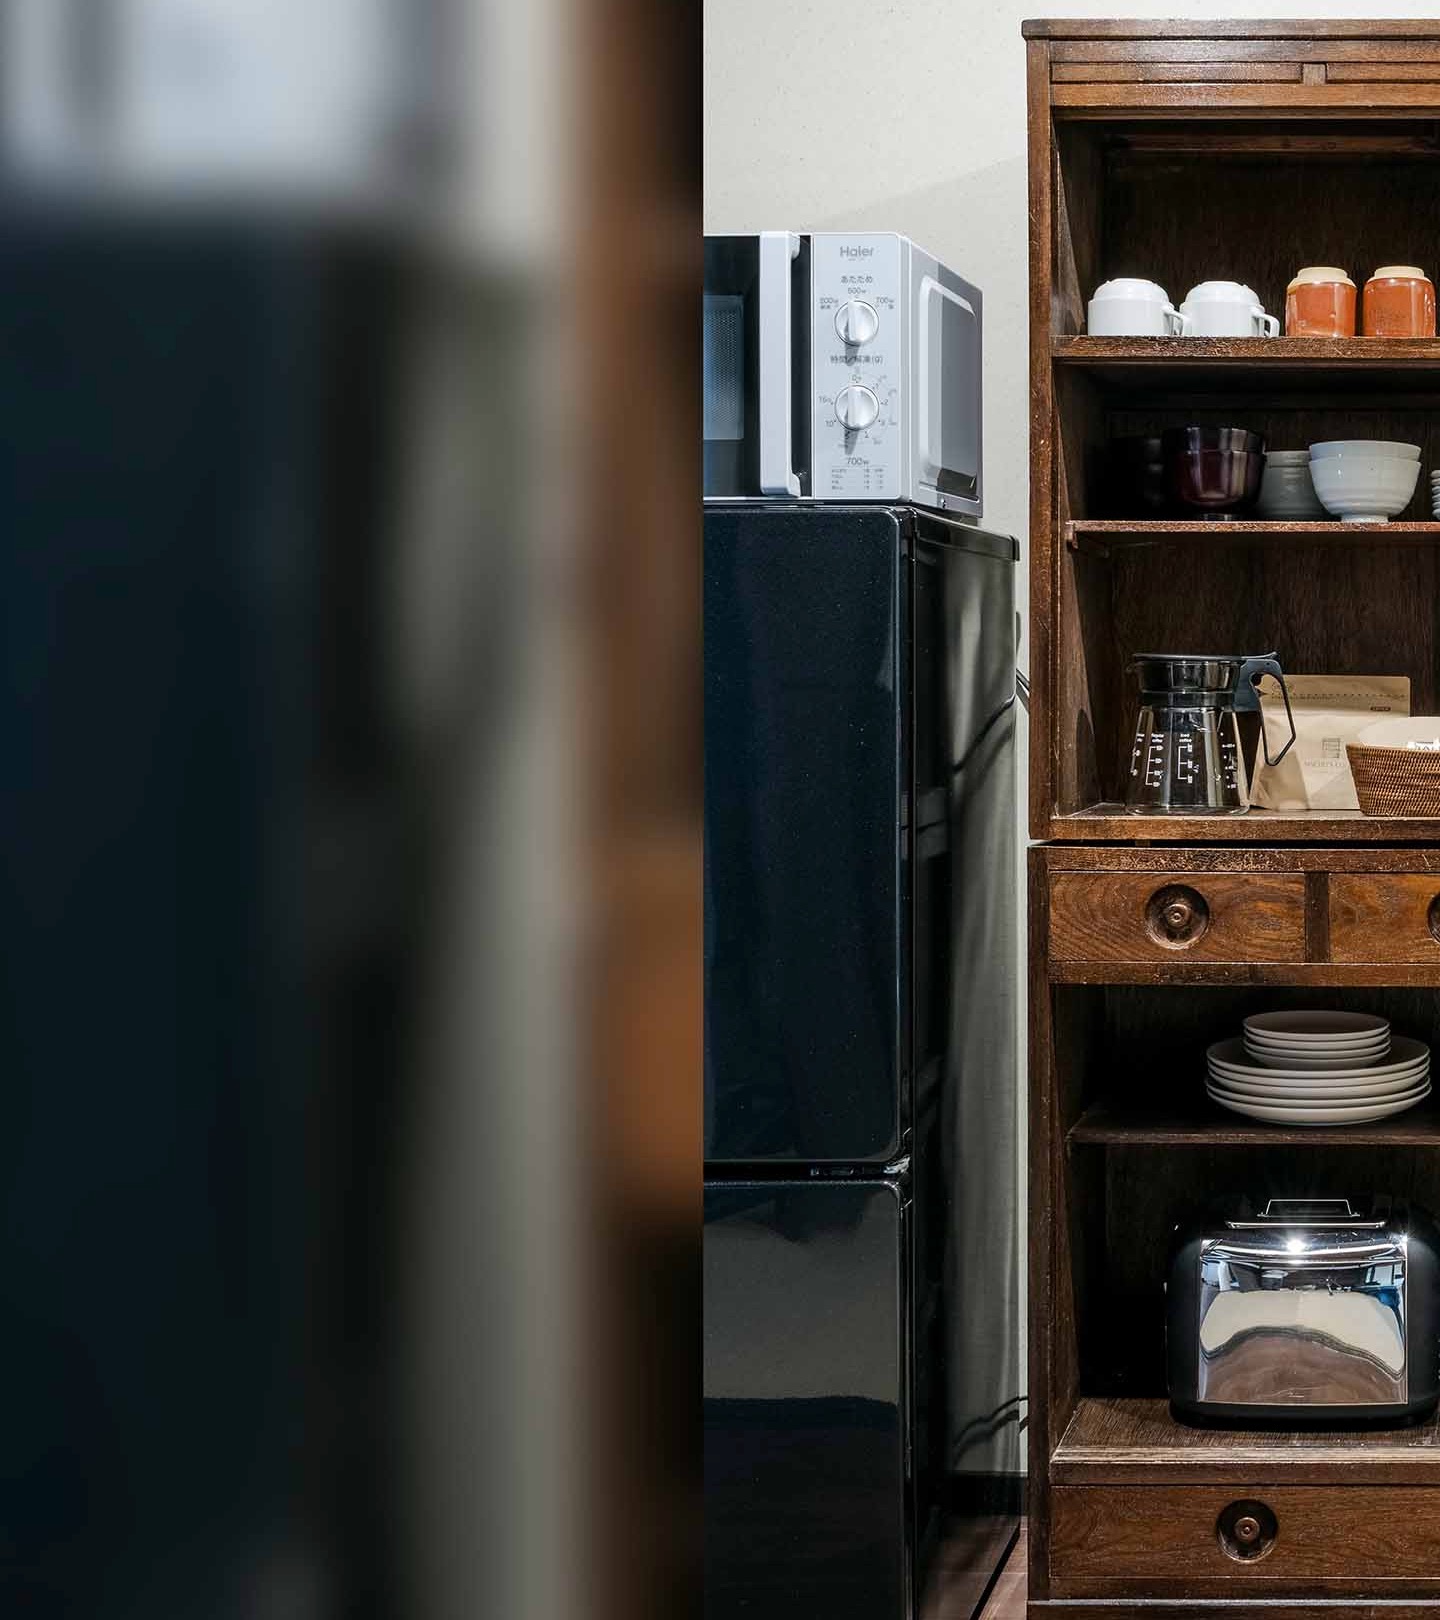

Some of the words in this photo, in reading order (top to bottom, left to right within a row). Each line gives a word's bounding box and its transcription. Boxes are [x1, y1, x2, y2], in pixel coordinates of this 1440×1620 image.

[839, 245, 874, 257] Haier
[841, 276, 873, 284] あたため
